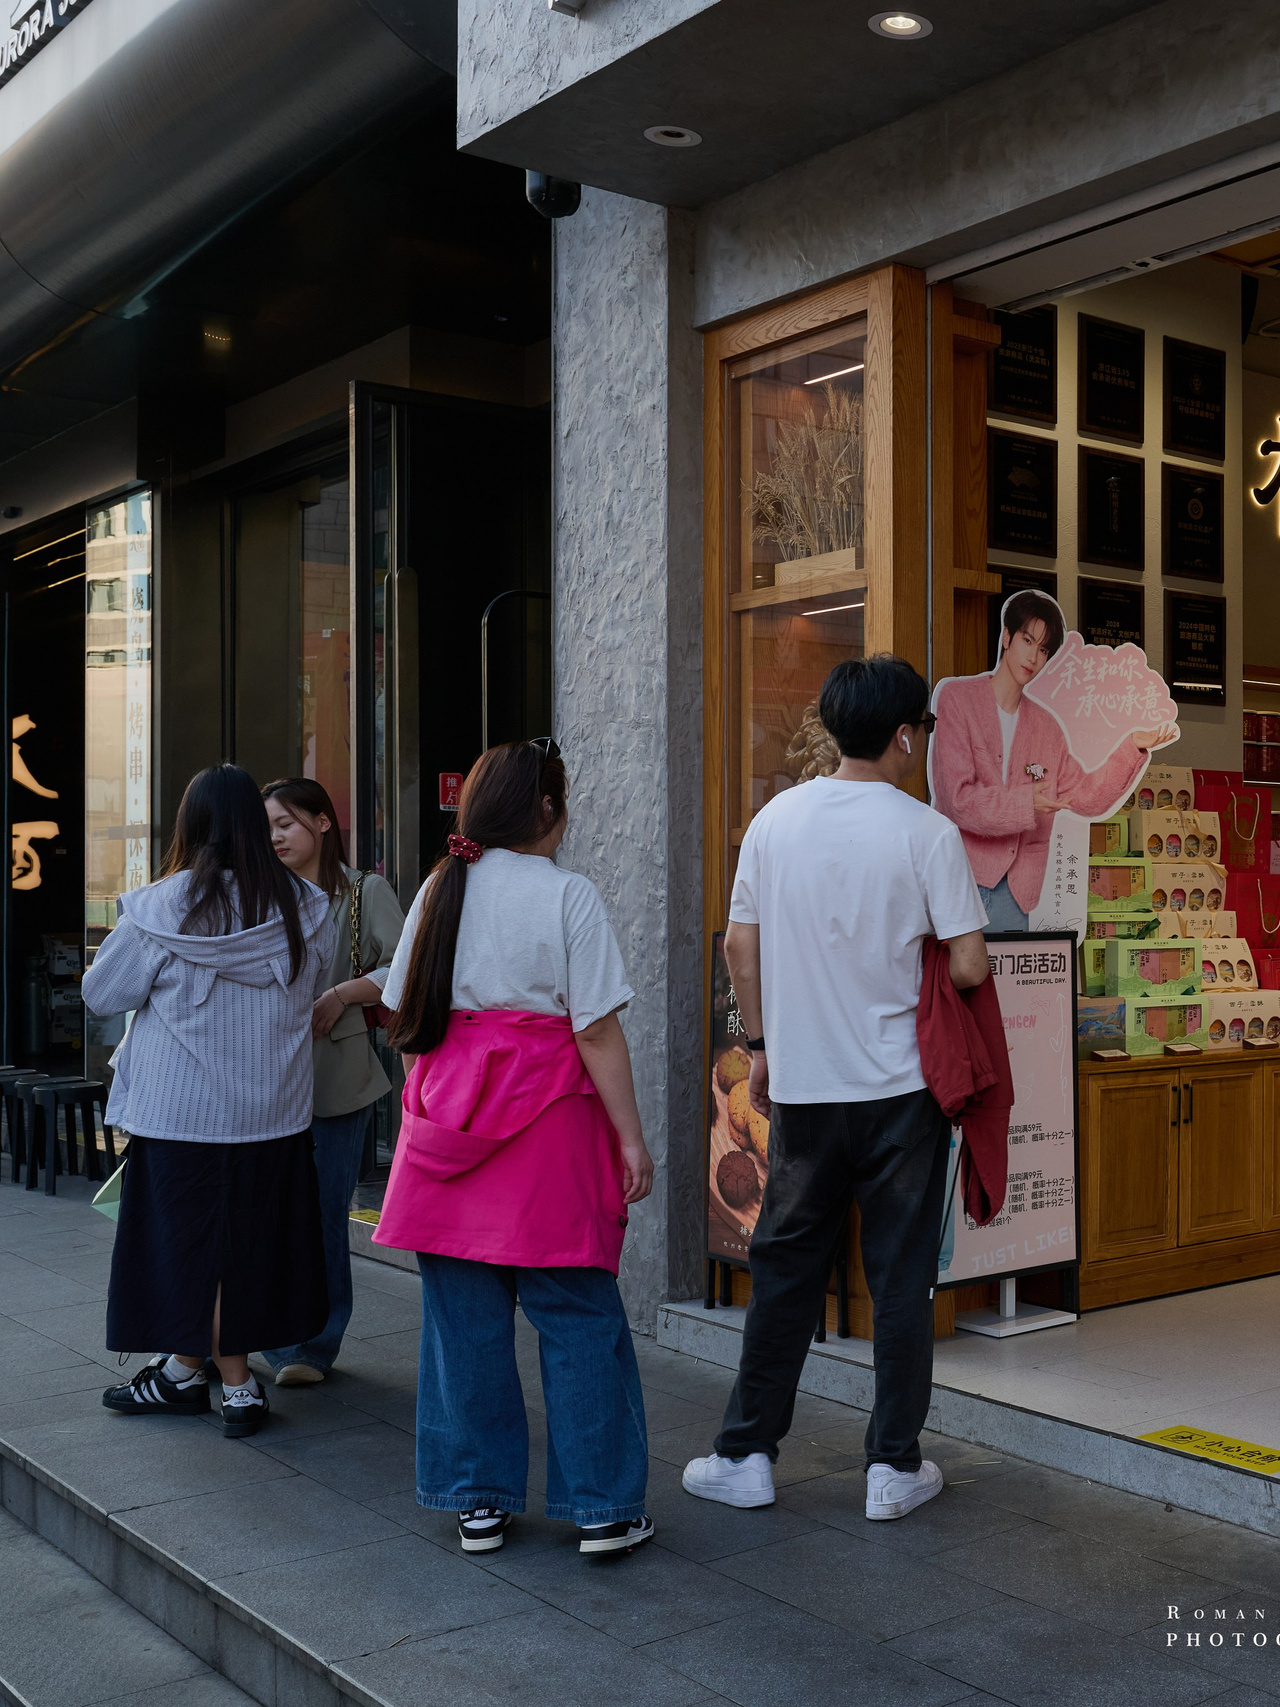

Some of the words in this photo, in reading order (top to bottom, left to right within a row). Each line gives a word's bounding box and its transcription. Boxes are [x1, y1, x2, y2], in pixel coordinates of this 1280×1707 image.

[1022, 978, 1054, 986] BEAUTIFUL
[971, 1242, 1017, 1274] JUST
[1024, 1225, 1074, 1256] LIKE!
